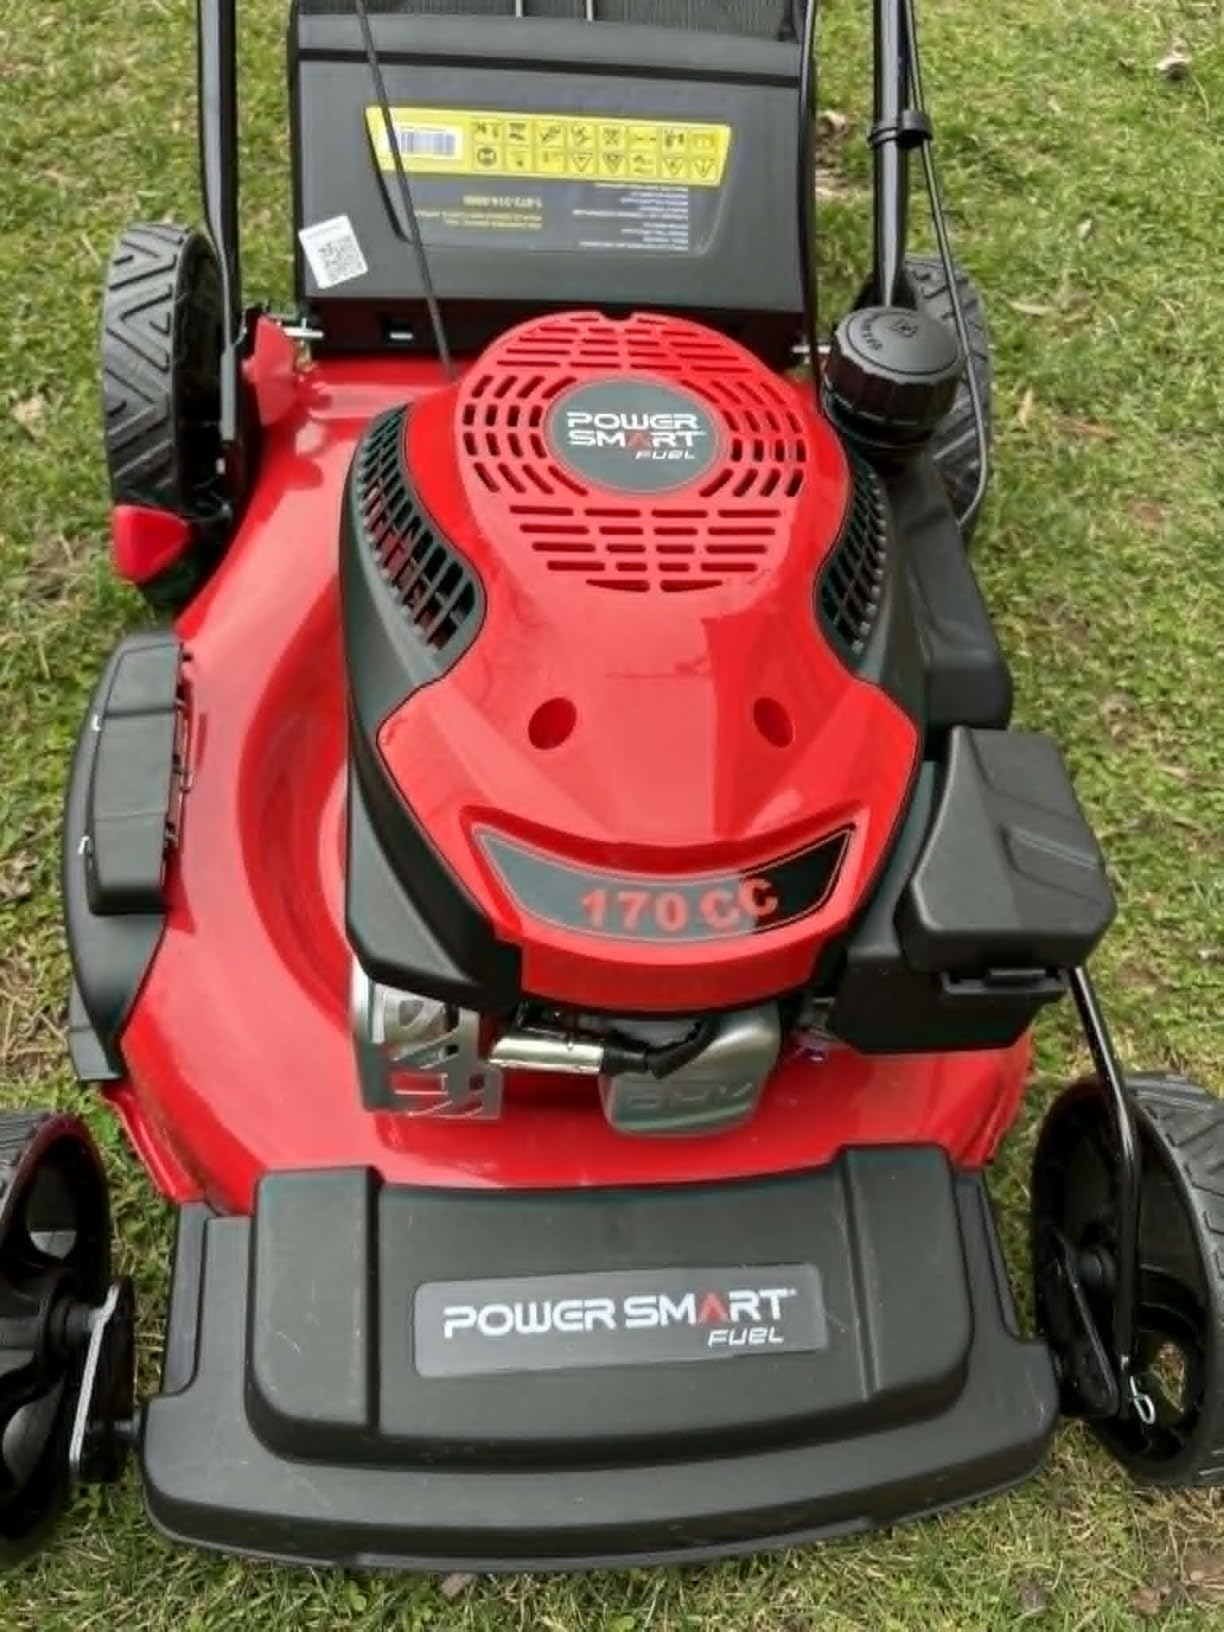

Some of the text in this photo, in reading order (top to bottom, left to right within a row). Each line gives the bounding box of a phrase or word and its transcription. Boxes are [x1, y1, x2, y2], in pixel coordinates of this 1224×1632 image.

[566, 411, 699, 430] POWER
[567, 429, 707, 448] SMART
[635, 450, 696, 460] FUEL
[581, 877, 778, 932] 170 CC
[443, 1288, 791, 1339] POWER SMART
[707, 1326, 785, 1347] FUEL
